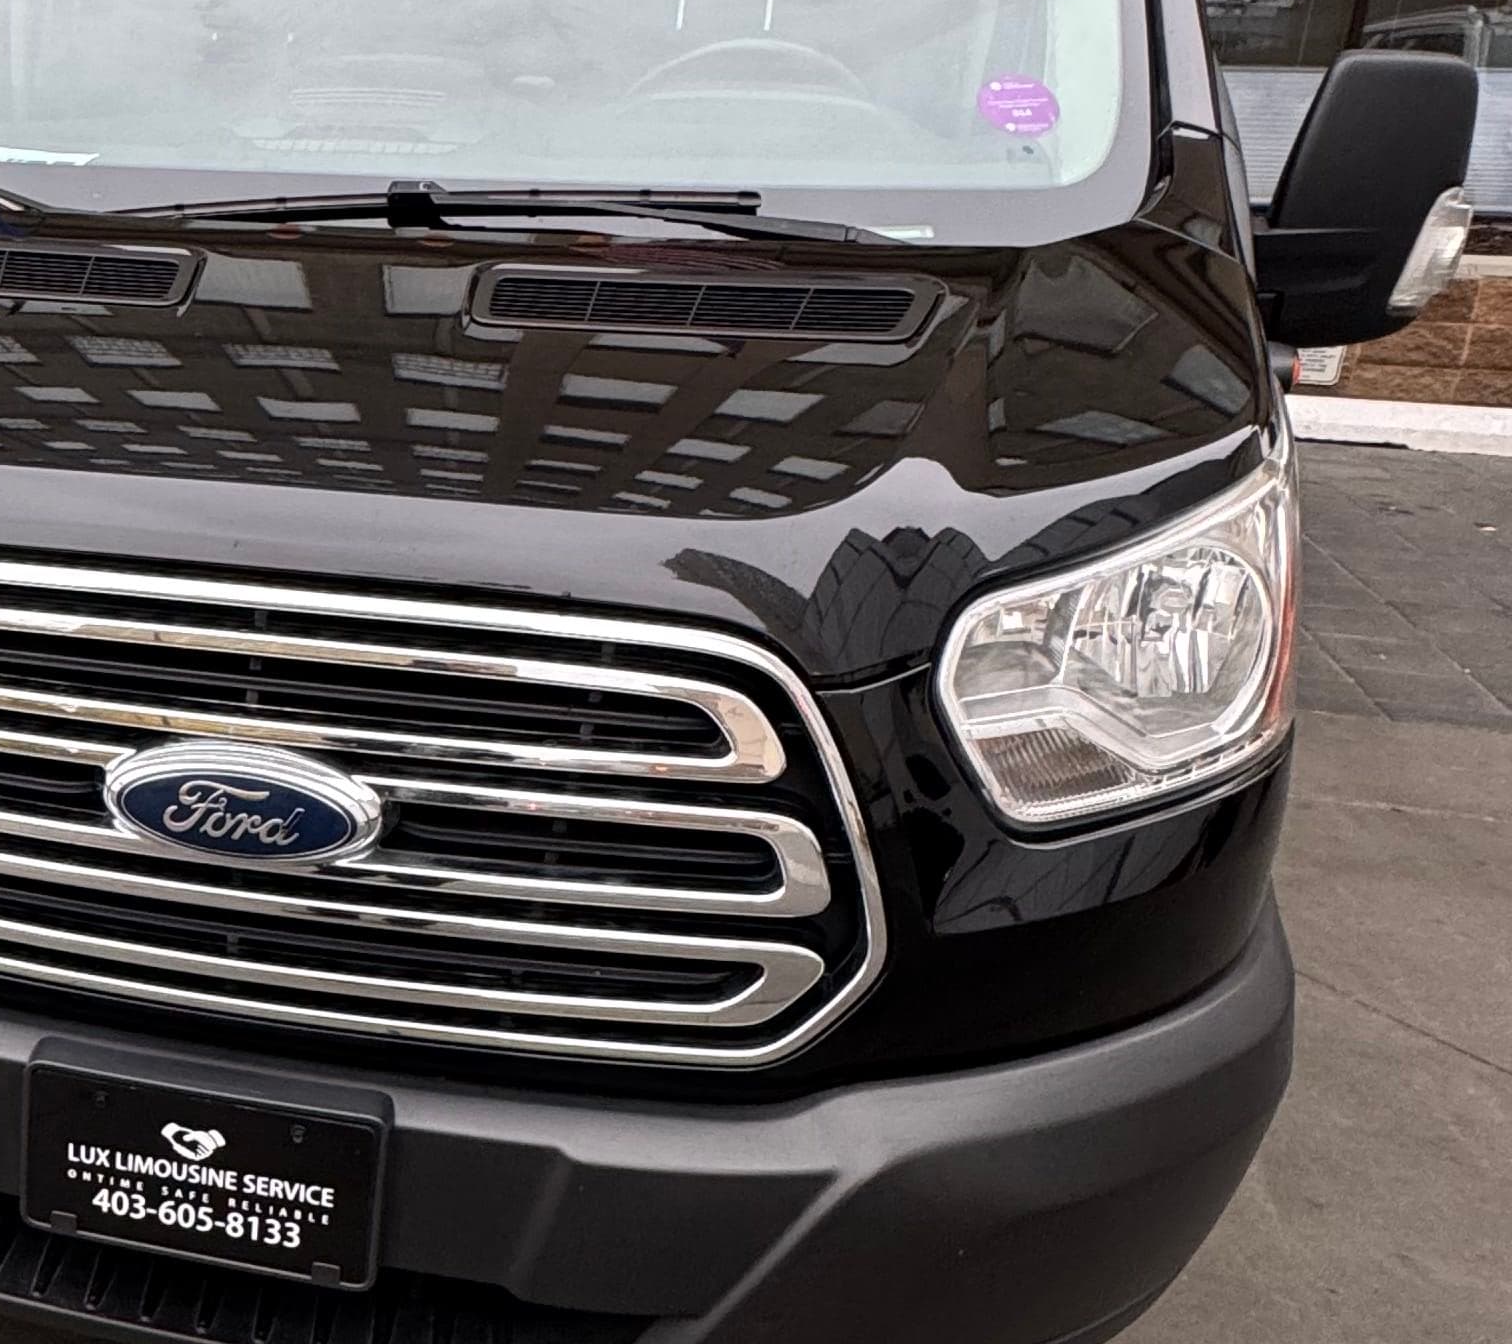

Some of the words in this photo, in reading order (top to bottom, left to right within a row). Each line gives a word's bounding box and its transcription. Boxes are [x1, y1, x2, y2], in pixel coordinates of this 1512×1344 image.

[163, 779, 305, 847] Ford
[67, 1142, 110, 1168] LUX
[115, 1155, 238, 1191] LIMOUSINE
[242, 1173, 335, 1209] SERVICE
[67, 1168, 145, 1192] ONTIME
[160, 1185, 211, 1204] SAFE
[228, 1198, 330, 1226] RELIABLE
[92, 1188, 301, 1249] 403-605-8133
